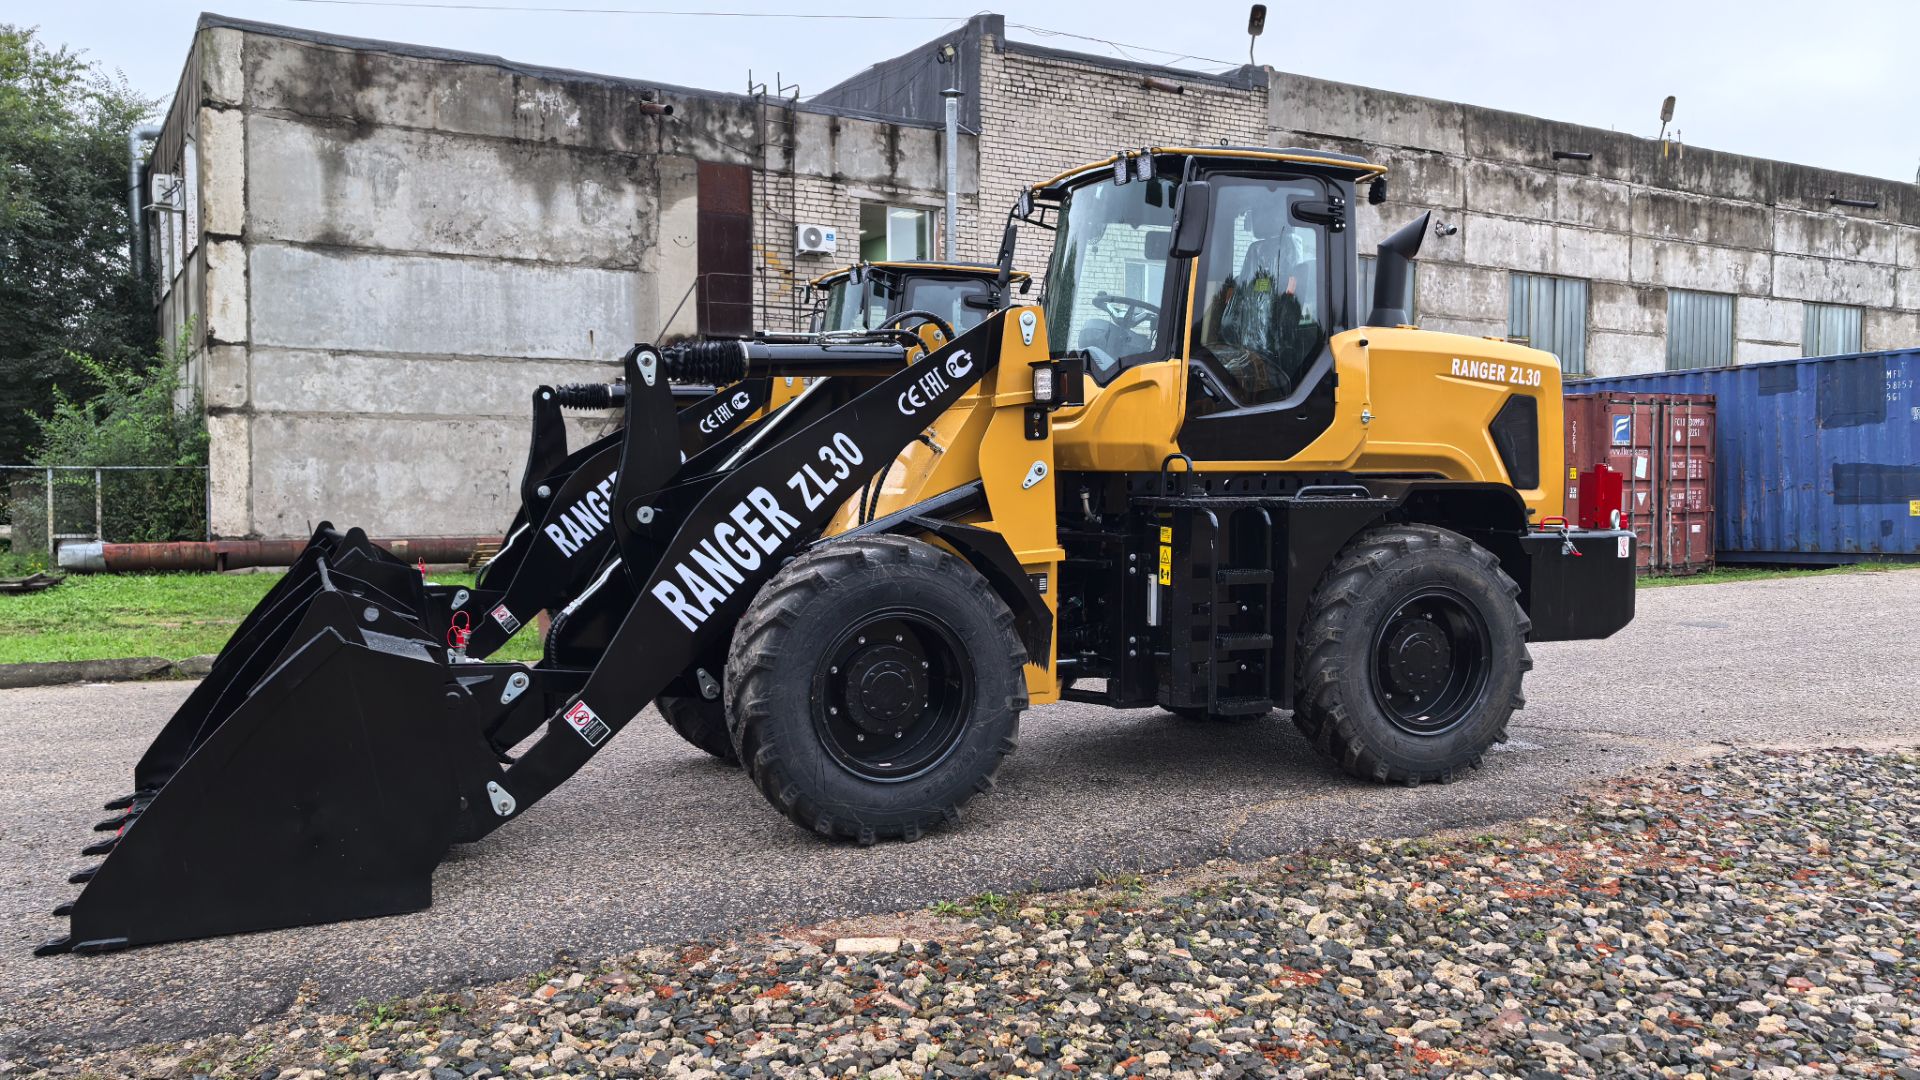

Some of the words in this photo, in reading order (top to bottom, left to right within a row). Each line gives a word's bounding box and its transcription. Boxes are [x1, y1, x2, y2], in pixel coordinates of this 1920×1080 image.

[1451, 358, 1506, 382] RANGER
[1509, 366, 1541, 387] ZL30
[544, 471, 618, 558] RANGE
[651, 486, 801, 633] RANGER
[786, 432, 864, 512] ZL30
